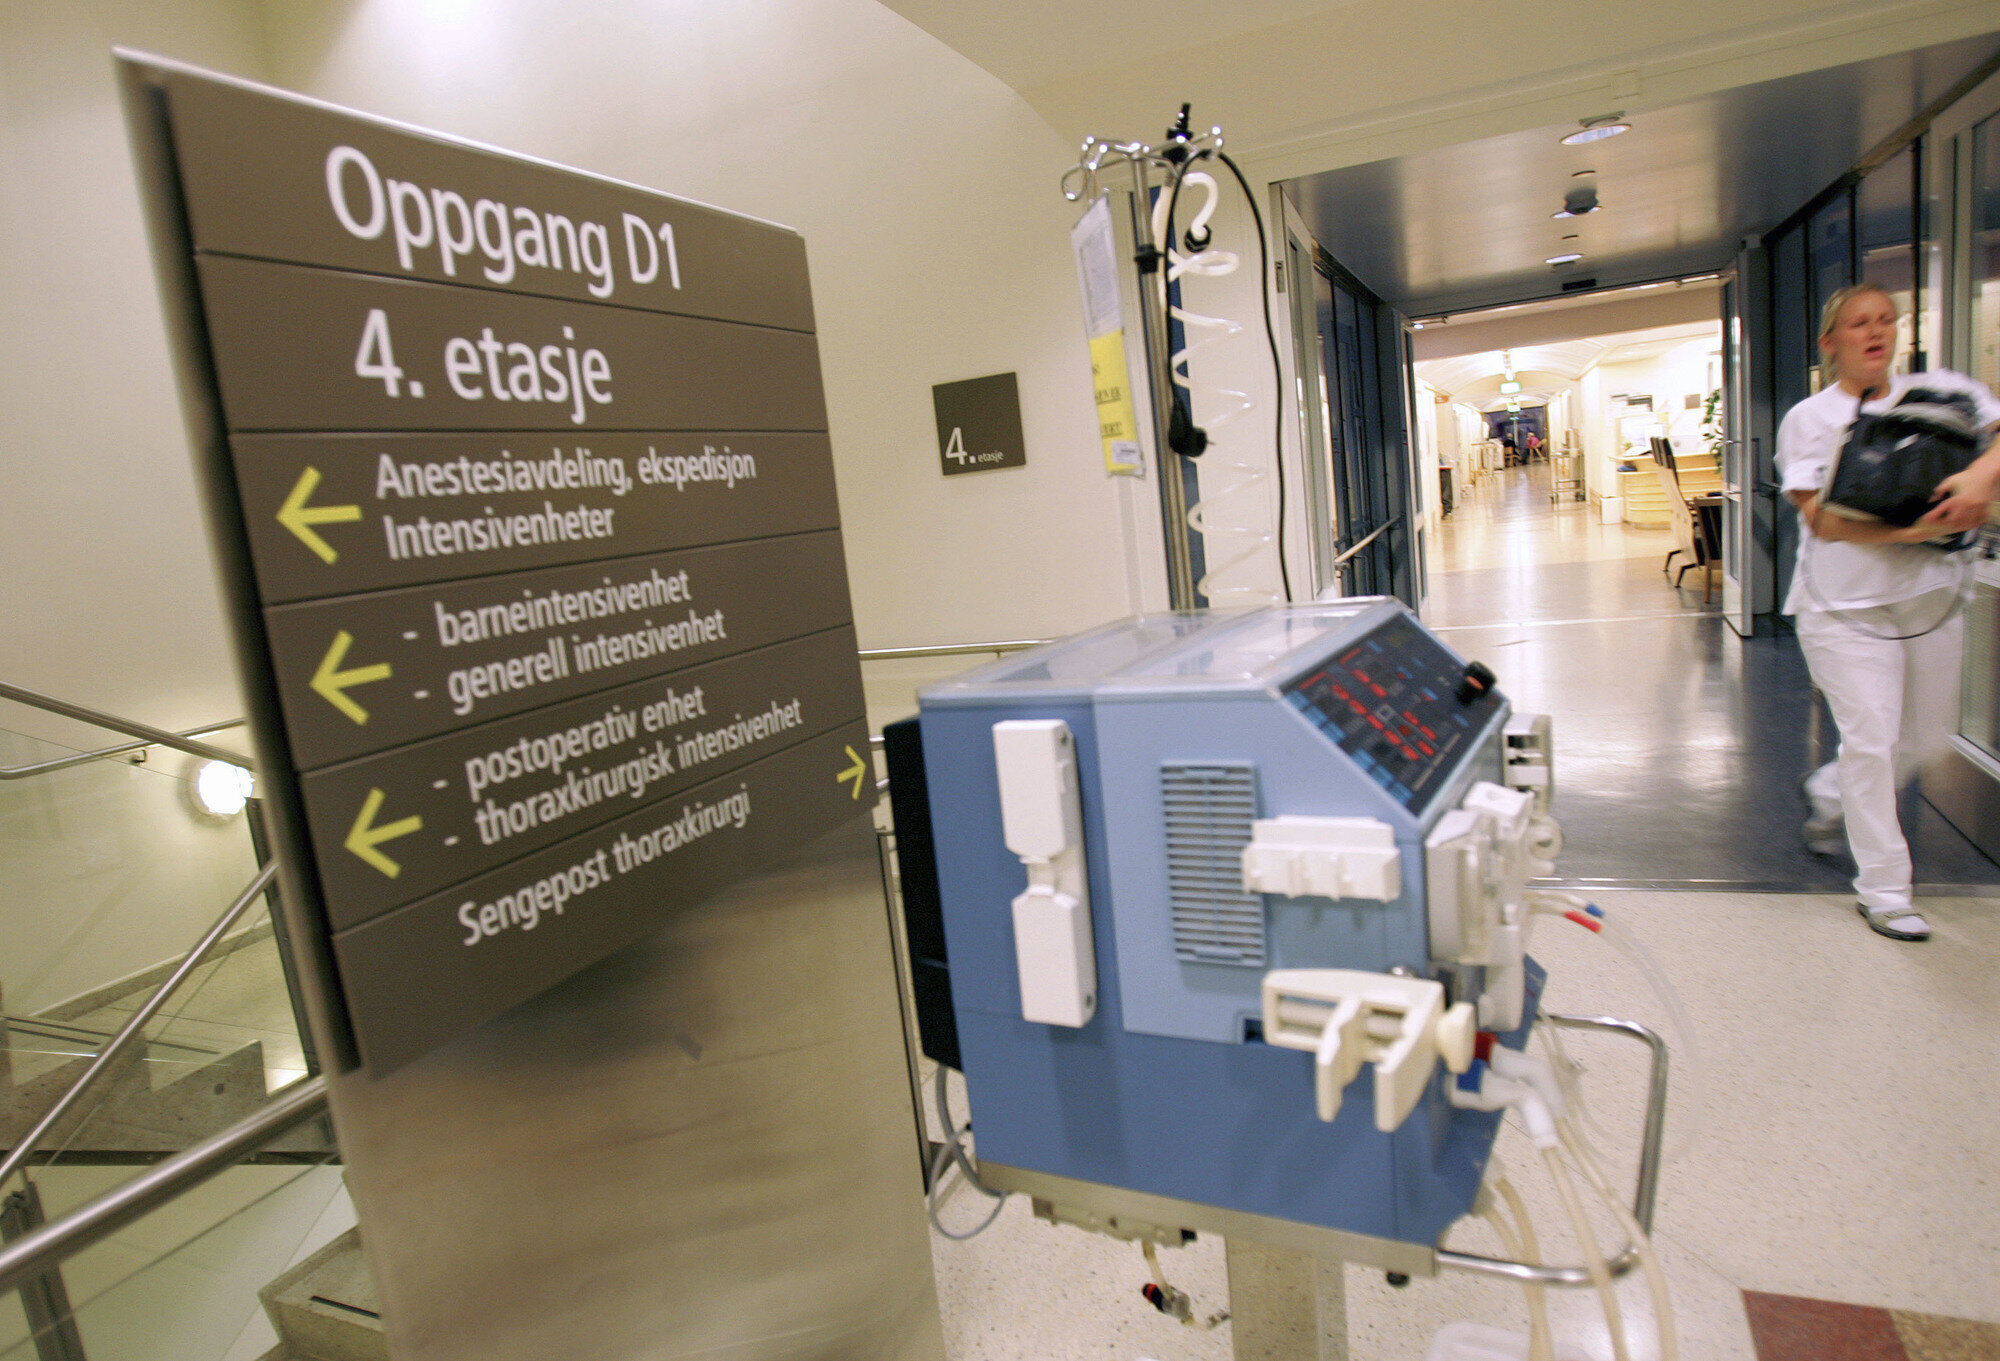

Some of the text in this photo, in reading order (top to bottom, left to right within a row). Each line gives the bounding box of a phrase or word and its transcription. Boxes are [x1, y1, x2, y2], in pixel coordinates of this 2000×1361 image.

[325, 144, 682, 299] Oppgang D1
[354, 308, 613, 425] 4. etasje
[376, 445, 756, 498] Anestesiavdeling, ekspedisjon
[945, 427, 1004, 465] 4. etasje
[383, 501, 615, 560] Intensivenheter
[434, 568, 692, 648] barneintensivenhet
[448, 635, 570, 716] generell
[573, 608, 727, 674] intensivenhet
[465, 704, 637, 802] postoperativ
[642, 685, 706, 733] enhet
[475, 740, 674, 846] thoraxkirurgisk
[676, 697, 802, 769] intensivenhet
[457, 782, 751, 947] Sengepost thoraxkirurgi
